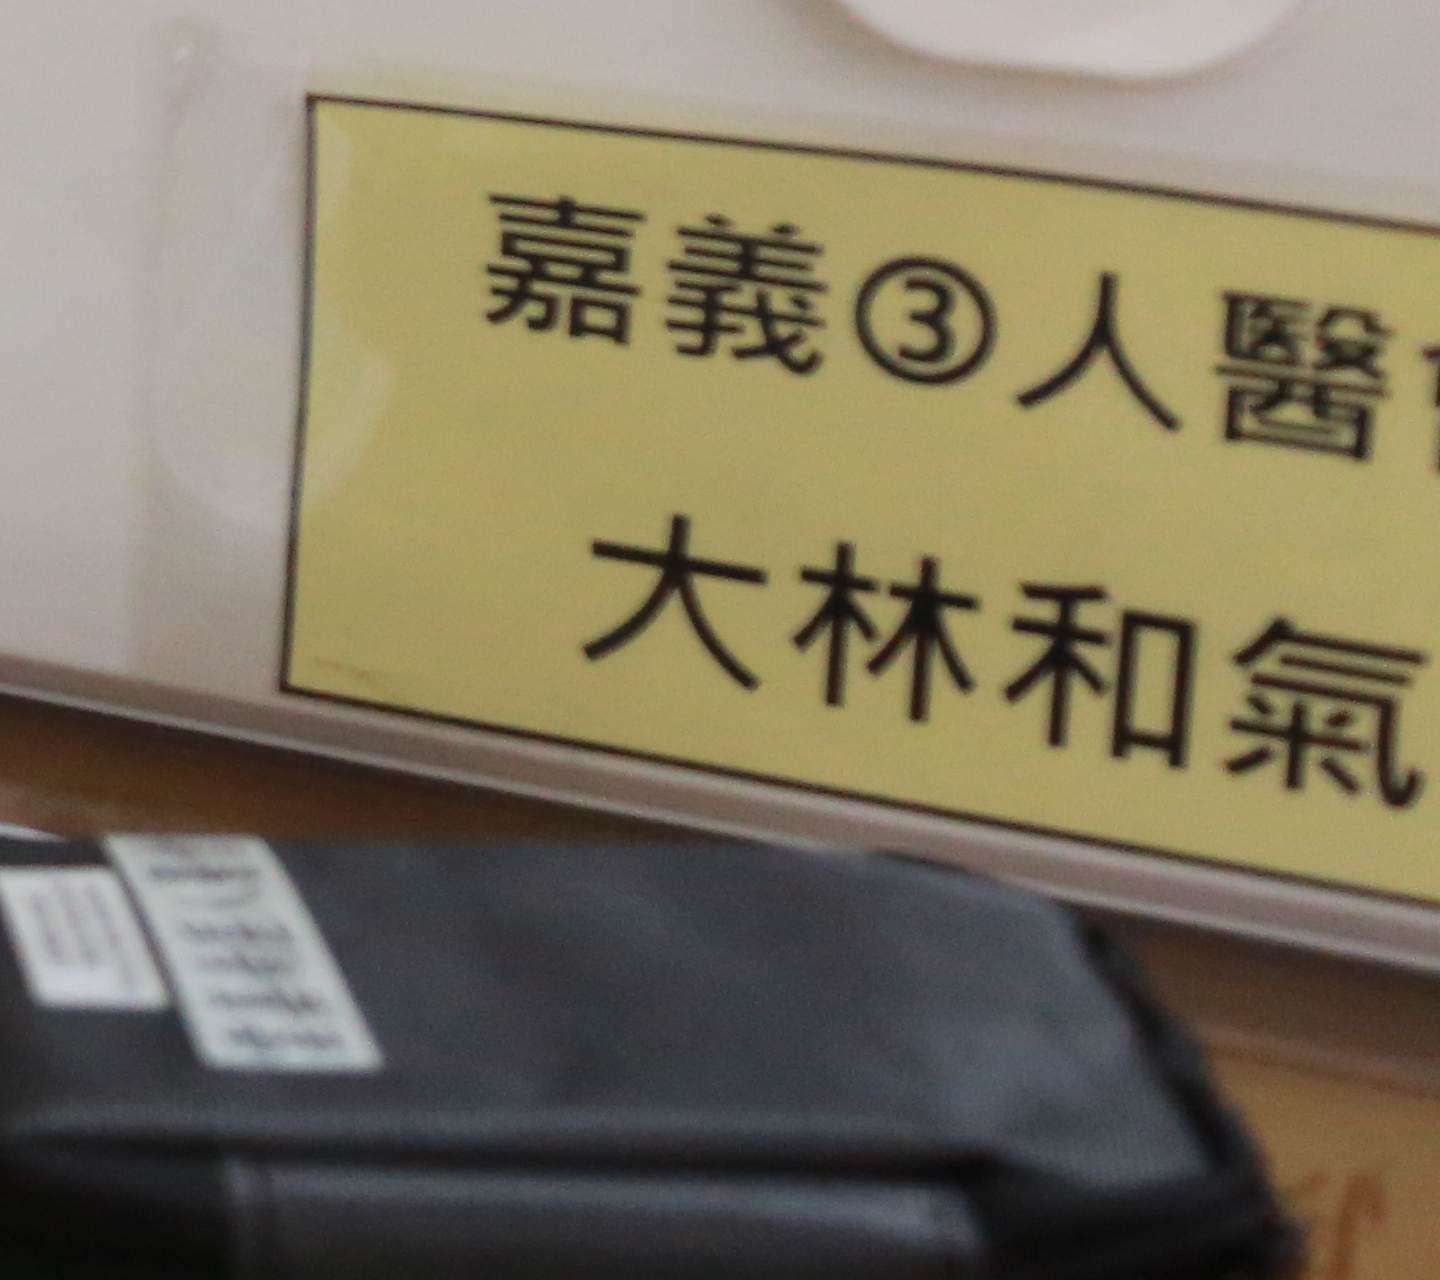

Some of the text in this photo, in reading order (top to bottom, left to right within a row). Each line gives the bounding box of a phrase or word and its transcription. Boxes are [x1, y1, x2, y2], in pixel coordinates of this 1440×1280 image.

[481, 191, 1440, 475] 嘉義③人醫
[583, 512, 1426, 810] 大林和氣
